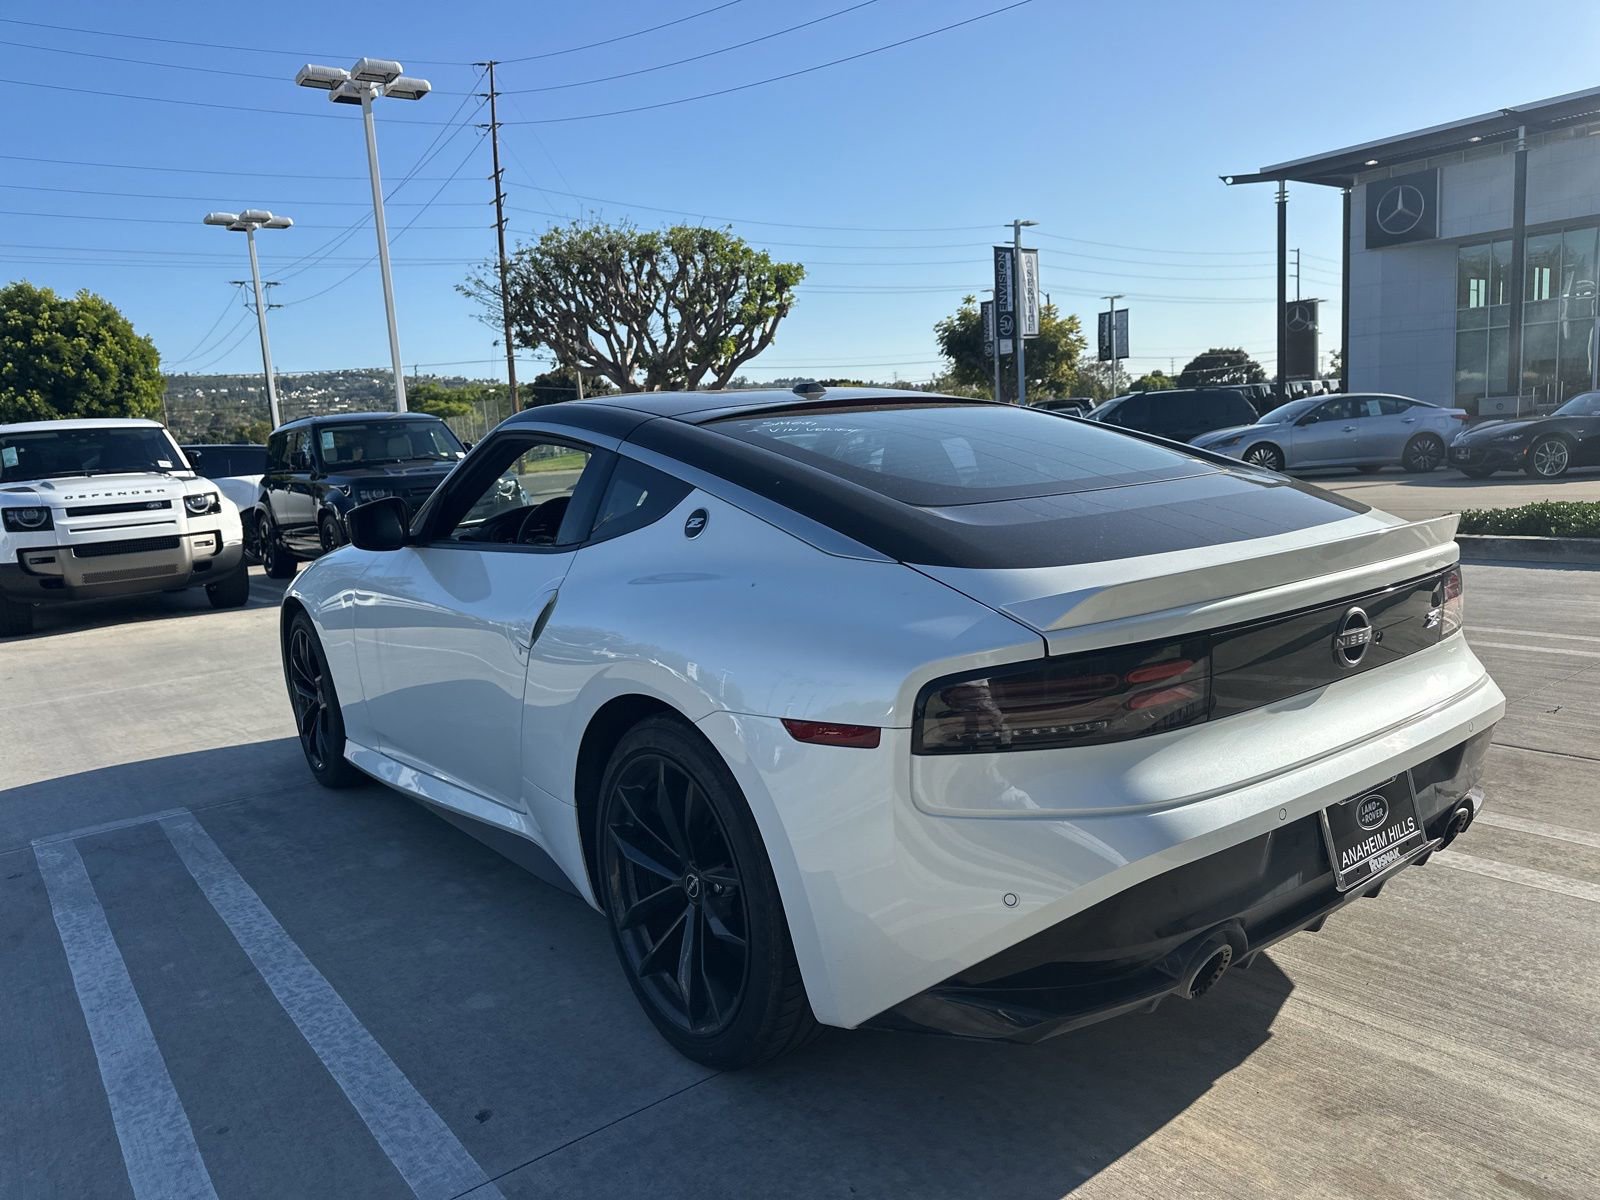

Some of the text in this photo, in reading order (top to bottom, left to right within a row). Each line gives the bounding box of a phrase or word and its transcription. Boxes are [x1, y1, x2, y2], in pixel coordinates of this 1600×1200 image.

[998, 251, 1008, 312] ENVISION
[1026, 268, 1035, 333] SERVICE
[64, 488, 166, 500] DEFENDER
[1336, 629, 1370, 648] NISS
[1342, 816, 1415, 868] ANAHEIM HILLS
[1368, 847, 1401, 872] RUSNAK
